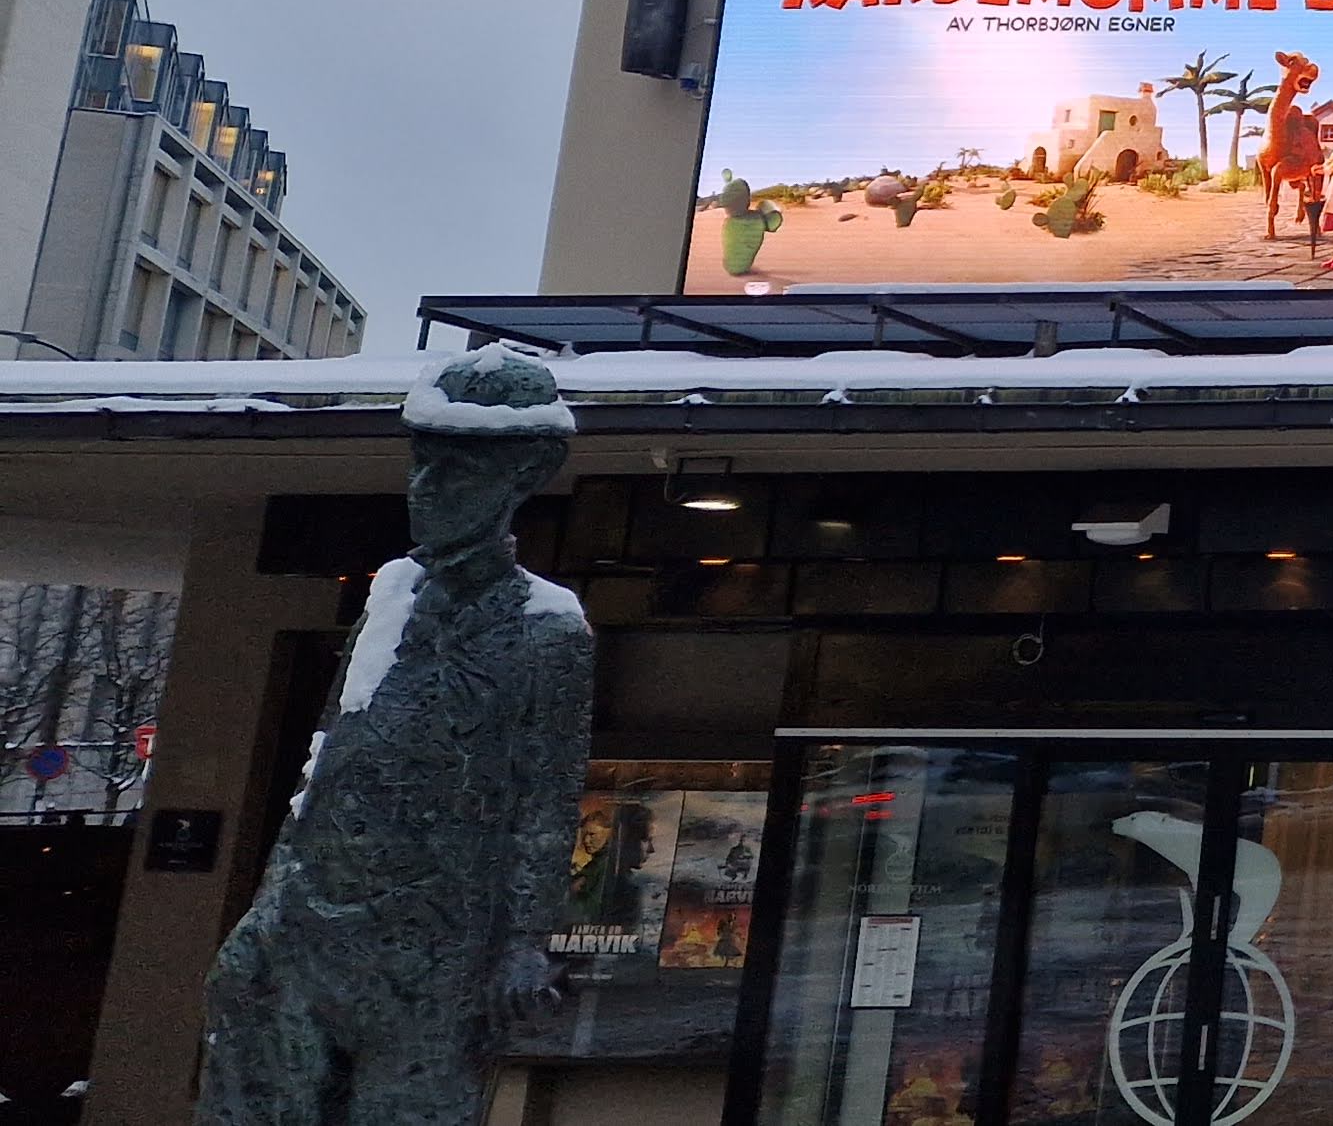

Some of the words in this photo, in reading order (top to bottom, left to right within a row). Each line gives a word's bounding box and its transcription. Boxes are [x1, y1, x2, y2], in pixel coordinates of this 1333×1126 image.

[946, 16, 975, 32] AV
[983, 16, 1100, 32] THORBJØRN
[1108, 16, 1176, 33] EGNER
[548, 933, 639, 953] NARVIK
